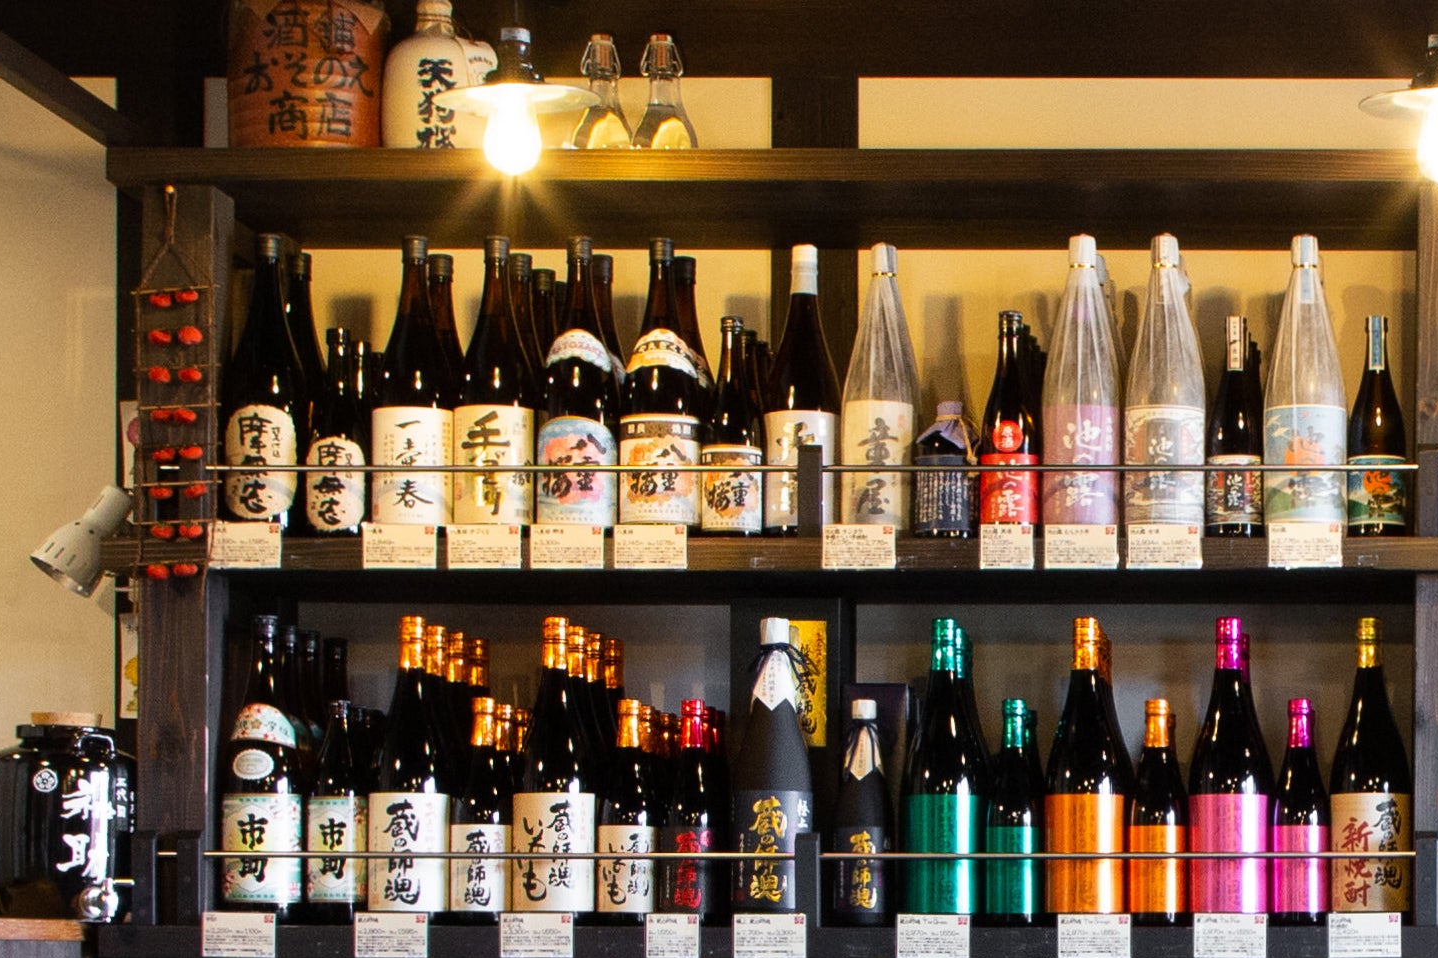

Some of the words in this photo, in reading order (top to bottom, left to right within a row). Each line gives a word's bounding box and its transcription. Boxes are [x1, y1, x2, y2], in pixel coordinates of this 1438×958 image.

[267, 90, 354, 140] 商店
[237, 813, 270, 883] 市助
[318, 817, 348, 881] 市助
[382, 798, 422, 905] 蔵の師魂
[627, 832, 649, 897] 蔵師魂
